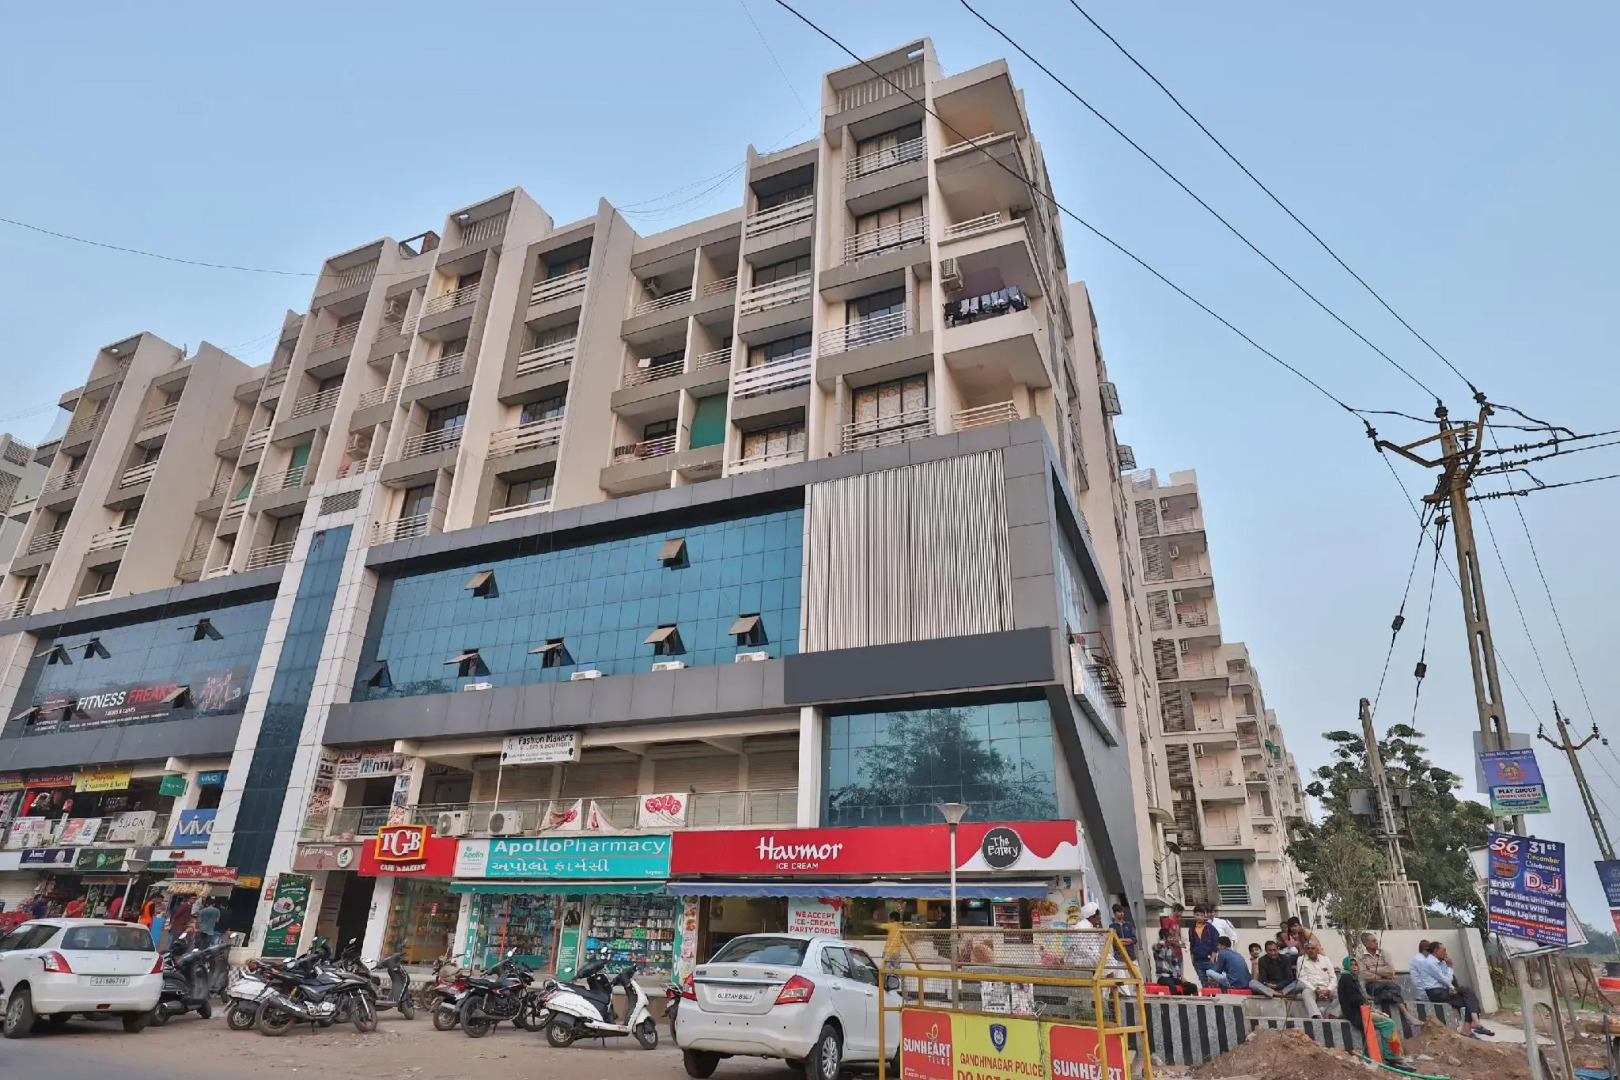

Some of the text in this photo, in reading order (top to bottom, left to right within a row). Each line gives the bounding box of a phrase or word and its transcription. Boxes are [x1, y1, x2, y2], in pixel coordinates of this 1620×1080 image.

[76, 691, 127, 711] FITNESS
[518, 733, 573, 745] Fashion Maker's
[381, 829, 422, 856] TGB
[990, 835, 1009, 847] The
[1490, 837, 1521, 853] 56
[755, 836, 843, 860] Havmor
[987, 845, 1018, 857] Eatery
[1529, 841, 1556, 855] 31st
[491, 858, 549, 872] અપોલો
[1525, 853, 1560, 864] December
[1525, 860, 1560, 872] Celebration
[1491, 879, 1515, 888] Enjoy
[1530, 895, 1566, 908] Unlimited
[807, 911, 836, 919] ACCEPT
[1490, 906, 1516, 916] Candle
[1517, 911, 1537, 920] Light
[1539, 916, 1565, 926] Dinner
[789, 925, 840, 935] PARTY ORDER
[903, 1037, 951, 1058] SUNHEART
[927, 1055, 950, 1066] TILES
[960, 1052, 1043, 1078] GANDHINAGAR POLICE
